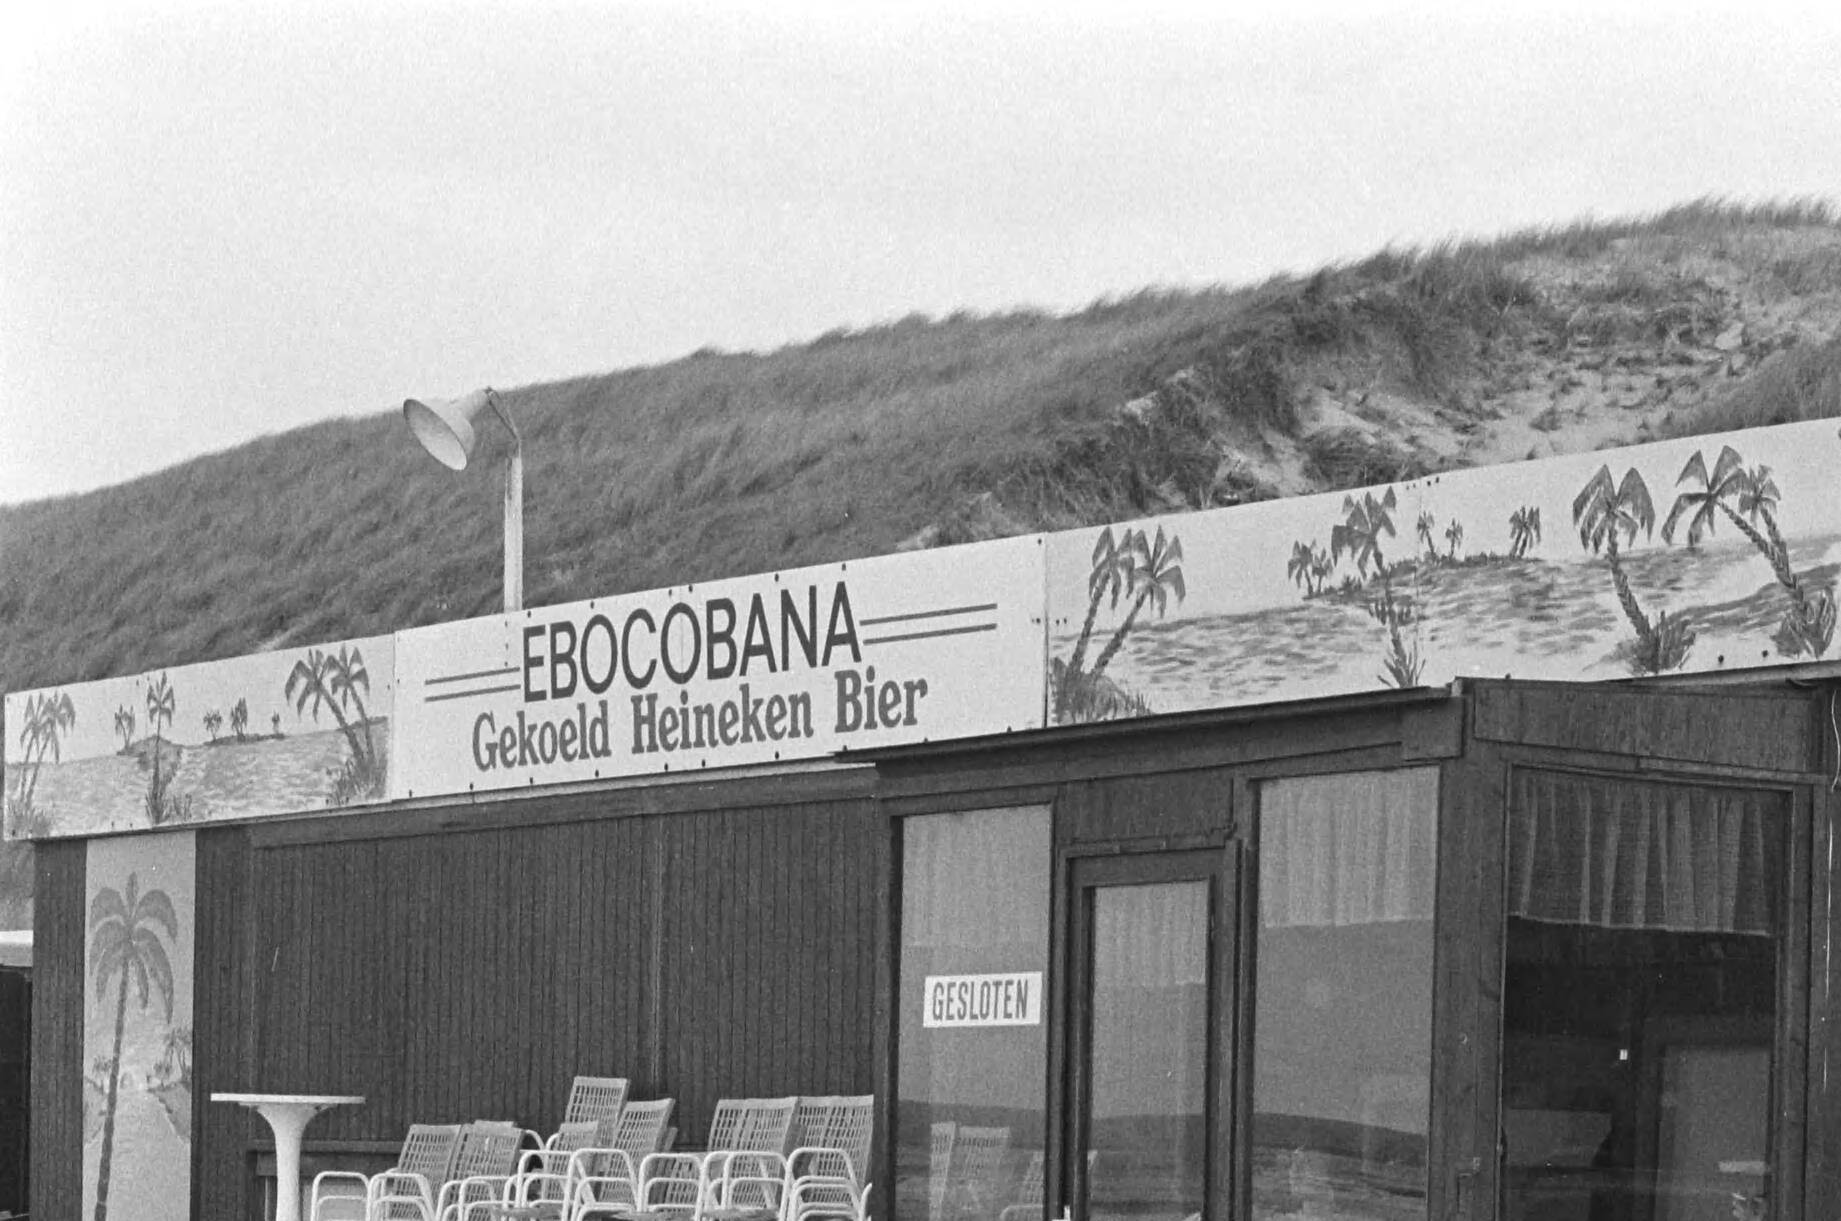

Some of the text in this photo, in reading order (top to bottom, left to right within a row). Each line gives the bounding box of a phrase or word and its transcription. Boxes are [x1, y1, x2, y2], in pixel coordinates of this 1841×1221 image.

[522, 580, 862, 702] EBOCOBANA
[471, 664, 928, 772] Gekoeld Heineken Bier
[932, 978, 1029, 1021] GESLOTEN
